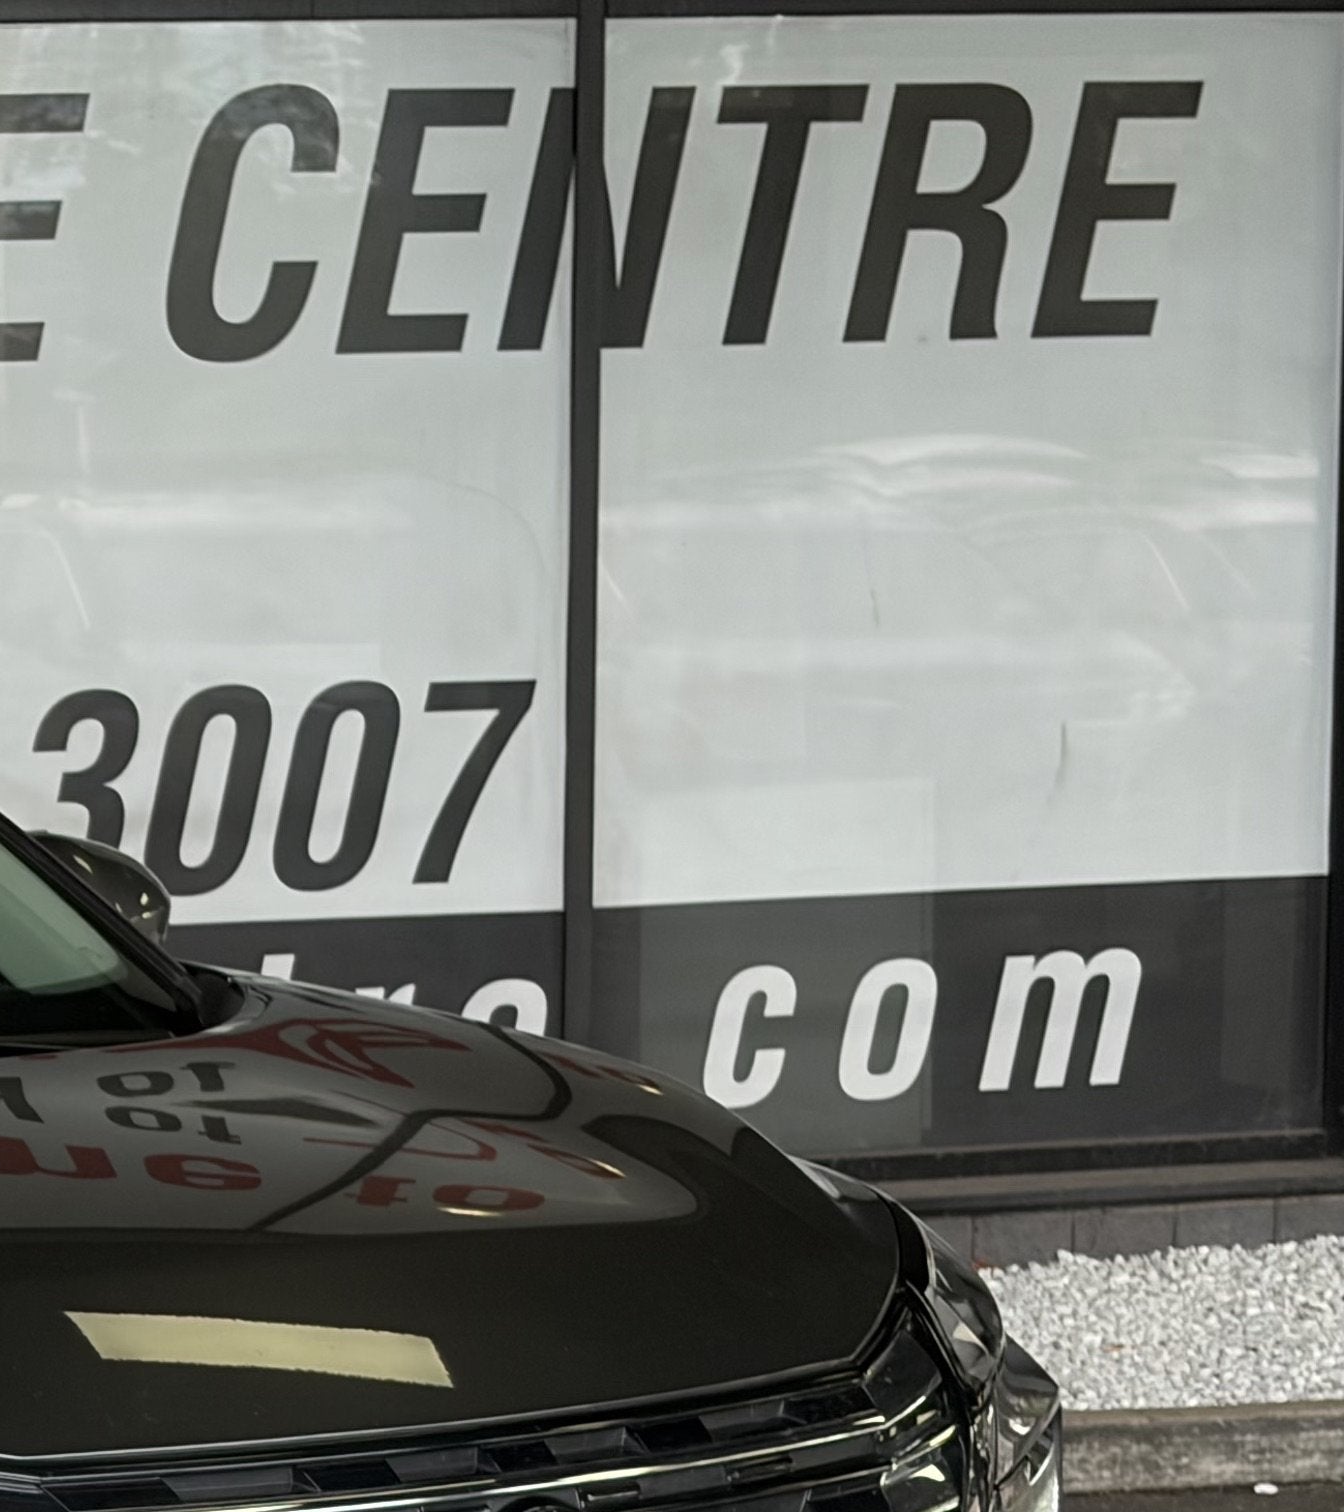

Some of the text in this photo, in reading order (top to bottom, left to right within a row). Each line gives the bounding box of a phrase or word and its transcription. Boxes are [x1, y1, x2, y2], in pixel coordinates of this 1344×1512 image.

[165, 81, 1203, 362] CENTRE
[32, 680, 535, 895] 3007
[703, 947, 1142, 1109] com
